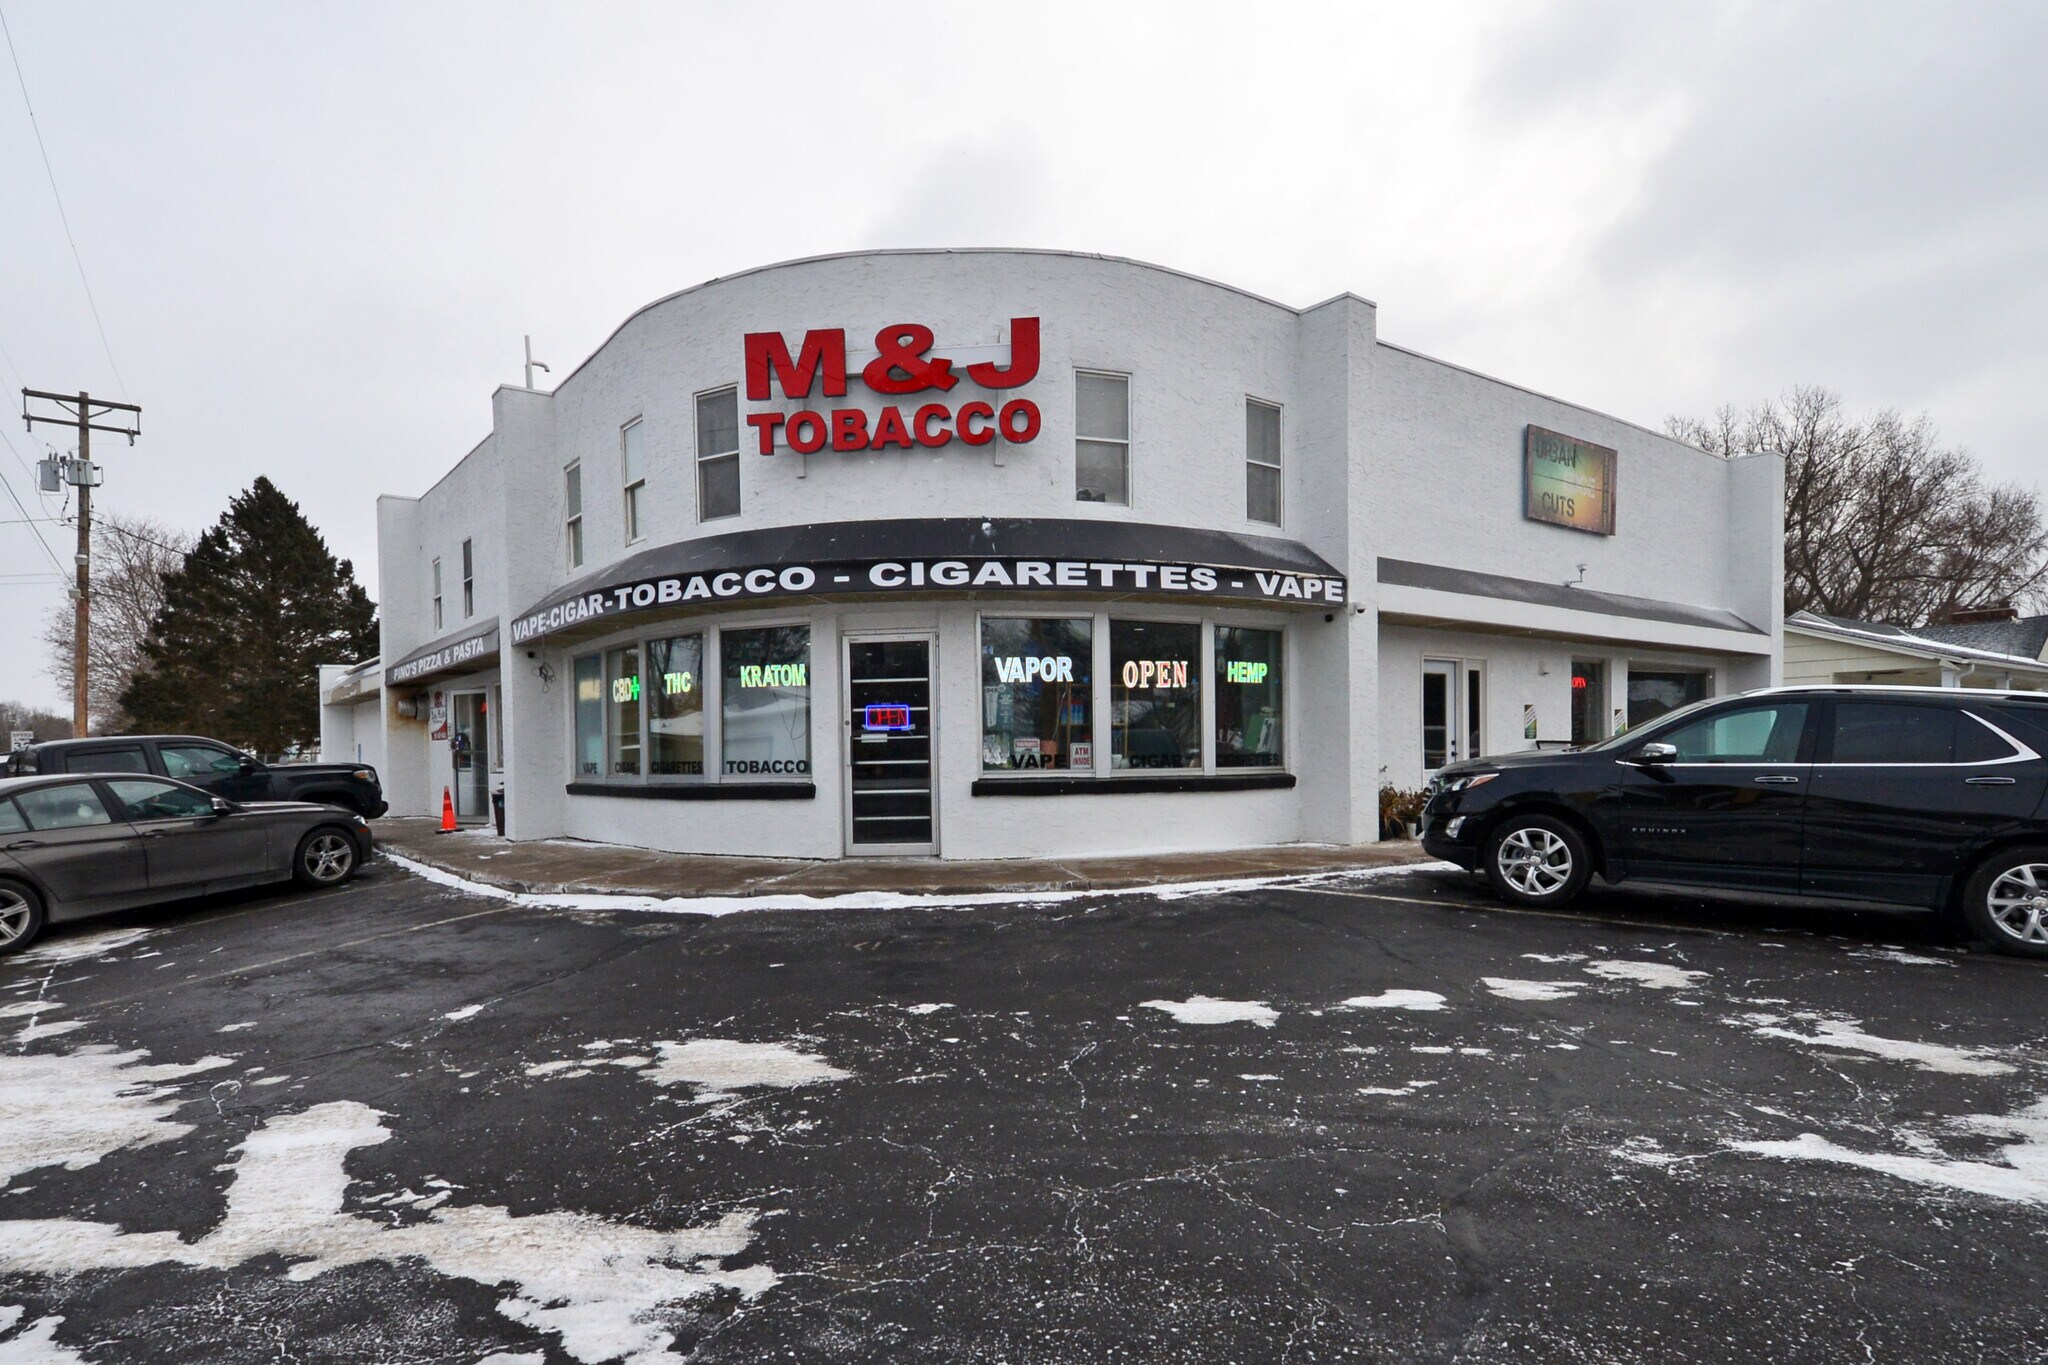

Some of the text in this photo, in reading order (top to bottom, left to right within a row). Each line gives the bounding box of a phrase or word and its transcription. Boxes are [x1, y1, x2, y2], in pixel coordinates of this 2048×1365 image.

[744, 316, 1041, 400] M & J
[746, 398, 1042, 456] TOBACCO
[1541, 491, 1576, 518] CUTS
[868, 561, 1218, 592] CIGARETTES
[1255, 572, 1344, 602] VAPE
[418, 653, 442, 674] PIZZA
[453, 637, 484, 661] PASTA
[740, 663, 806, 688] KRATOM
[994, 656, 1074, 683] VAPOR
[1123, 660, 1188, 689] OPEN
[1227, 661, 1268, 684] HEMP
[664, 671, 692, 695] THC
[869, 708, 908, 726] OPEN
[1011, 754, 1067, 769] VAPE
[1073, 757, 1090, 766] INSIDE
[1074, 747, 1089, 756] ATM
[1129, 754, 1183, 768] CIGAR
[583, 762, 598, 774] VAPE
[614, 762, 636, 774] CIGAR
[651, 761, 703, 774] CIGARETTES
[726, 760, 808, 774] TOBACCO
